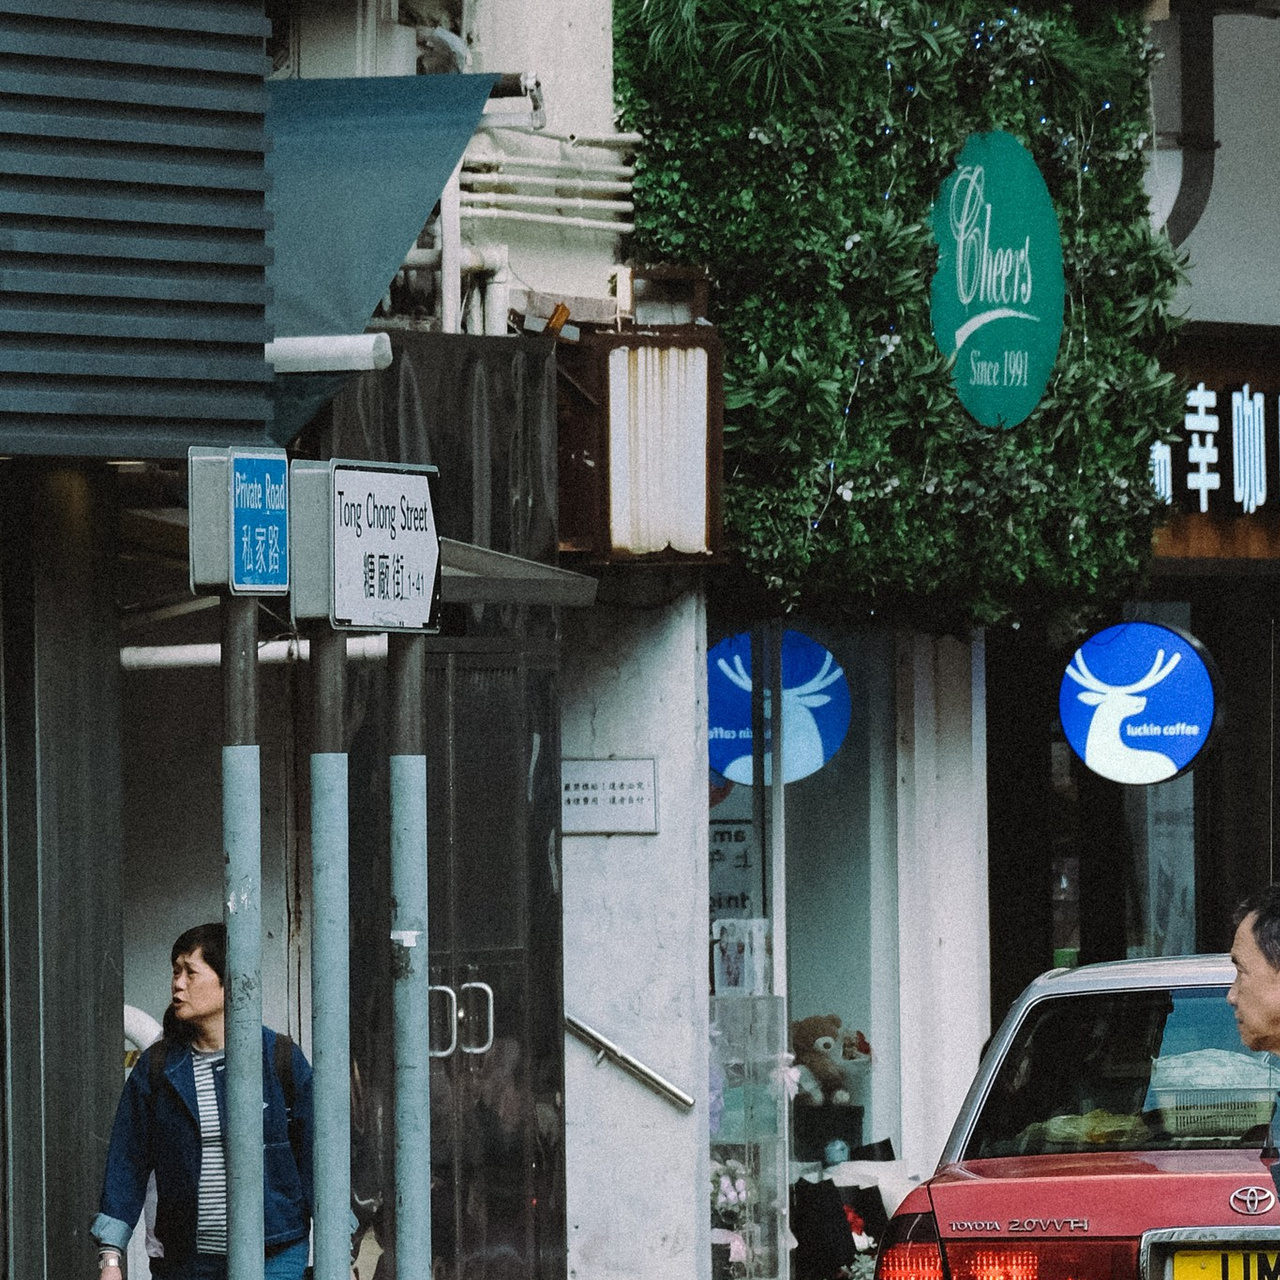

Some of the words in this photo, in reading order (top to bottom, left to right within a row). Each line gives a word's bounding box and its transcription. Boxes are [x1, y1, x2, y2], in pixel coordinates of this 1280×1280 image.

[950, 165, 1032, 305] Cheers
[970, 350, 999, 386] Since
[1003, 350, 1028, 386] 1991
[235, 471, 262, 510] Private
[265, 472, 285, 510] Road
[337, 490, 362, 538] Tong
[366, 492, 396, 540] Chong
[400, 494, 428, 532] Street
[242, 524, 279, 574] 私家路
[1126, 723, 1161, 736] luckin
[1163, 722, 1200, 736] coffee
[949, 1220, 1001, 1232] TOYOTA
